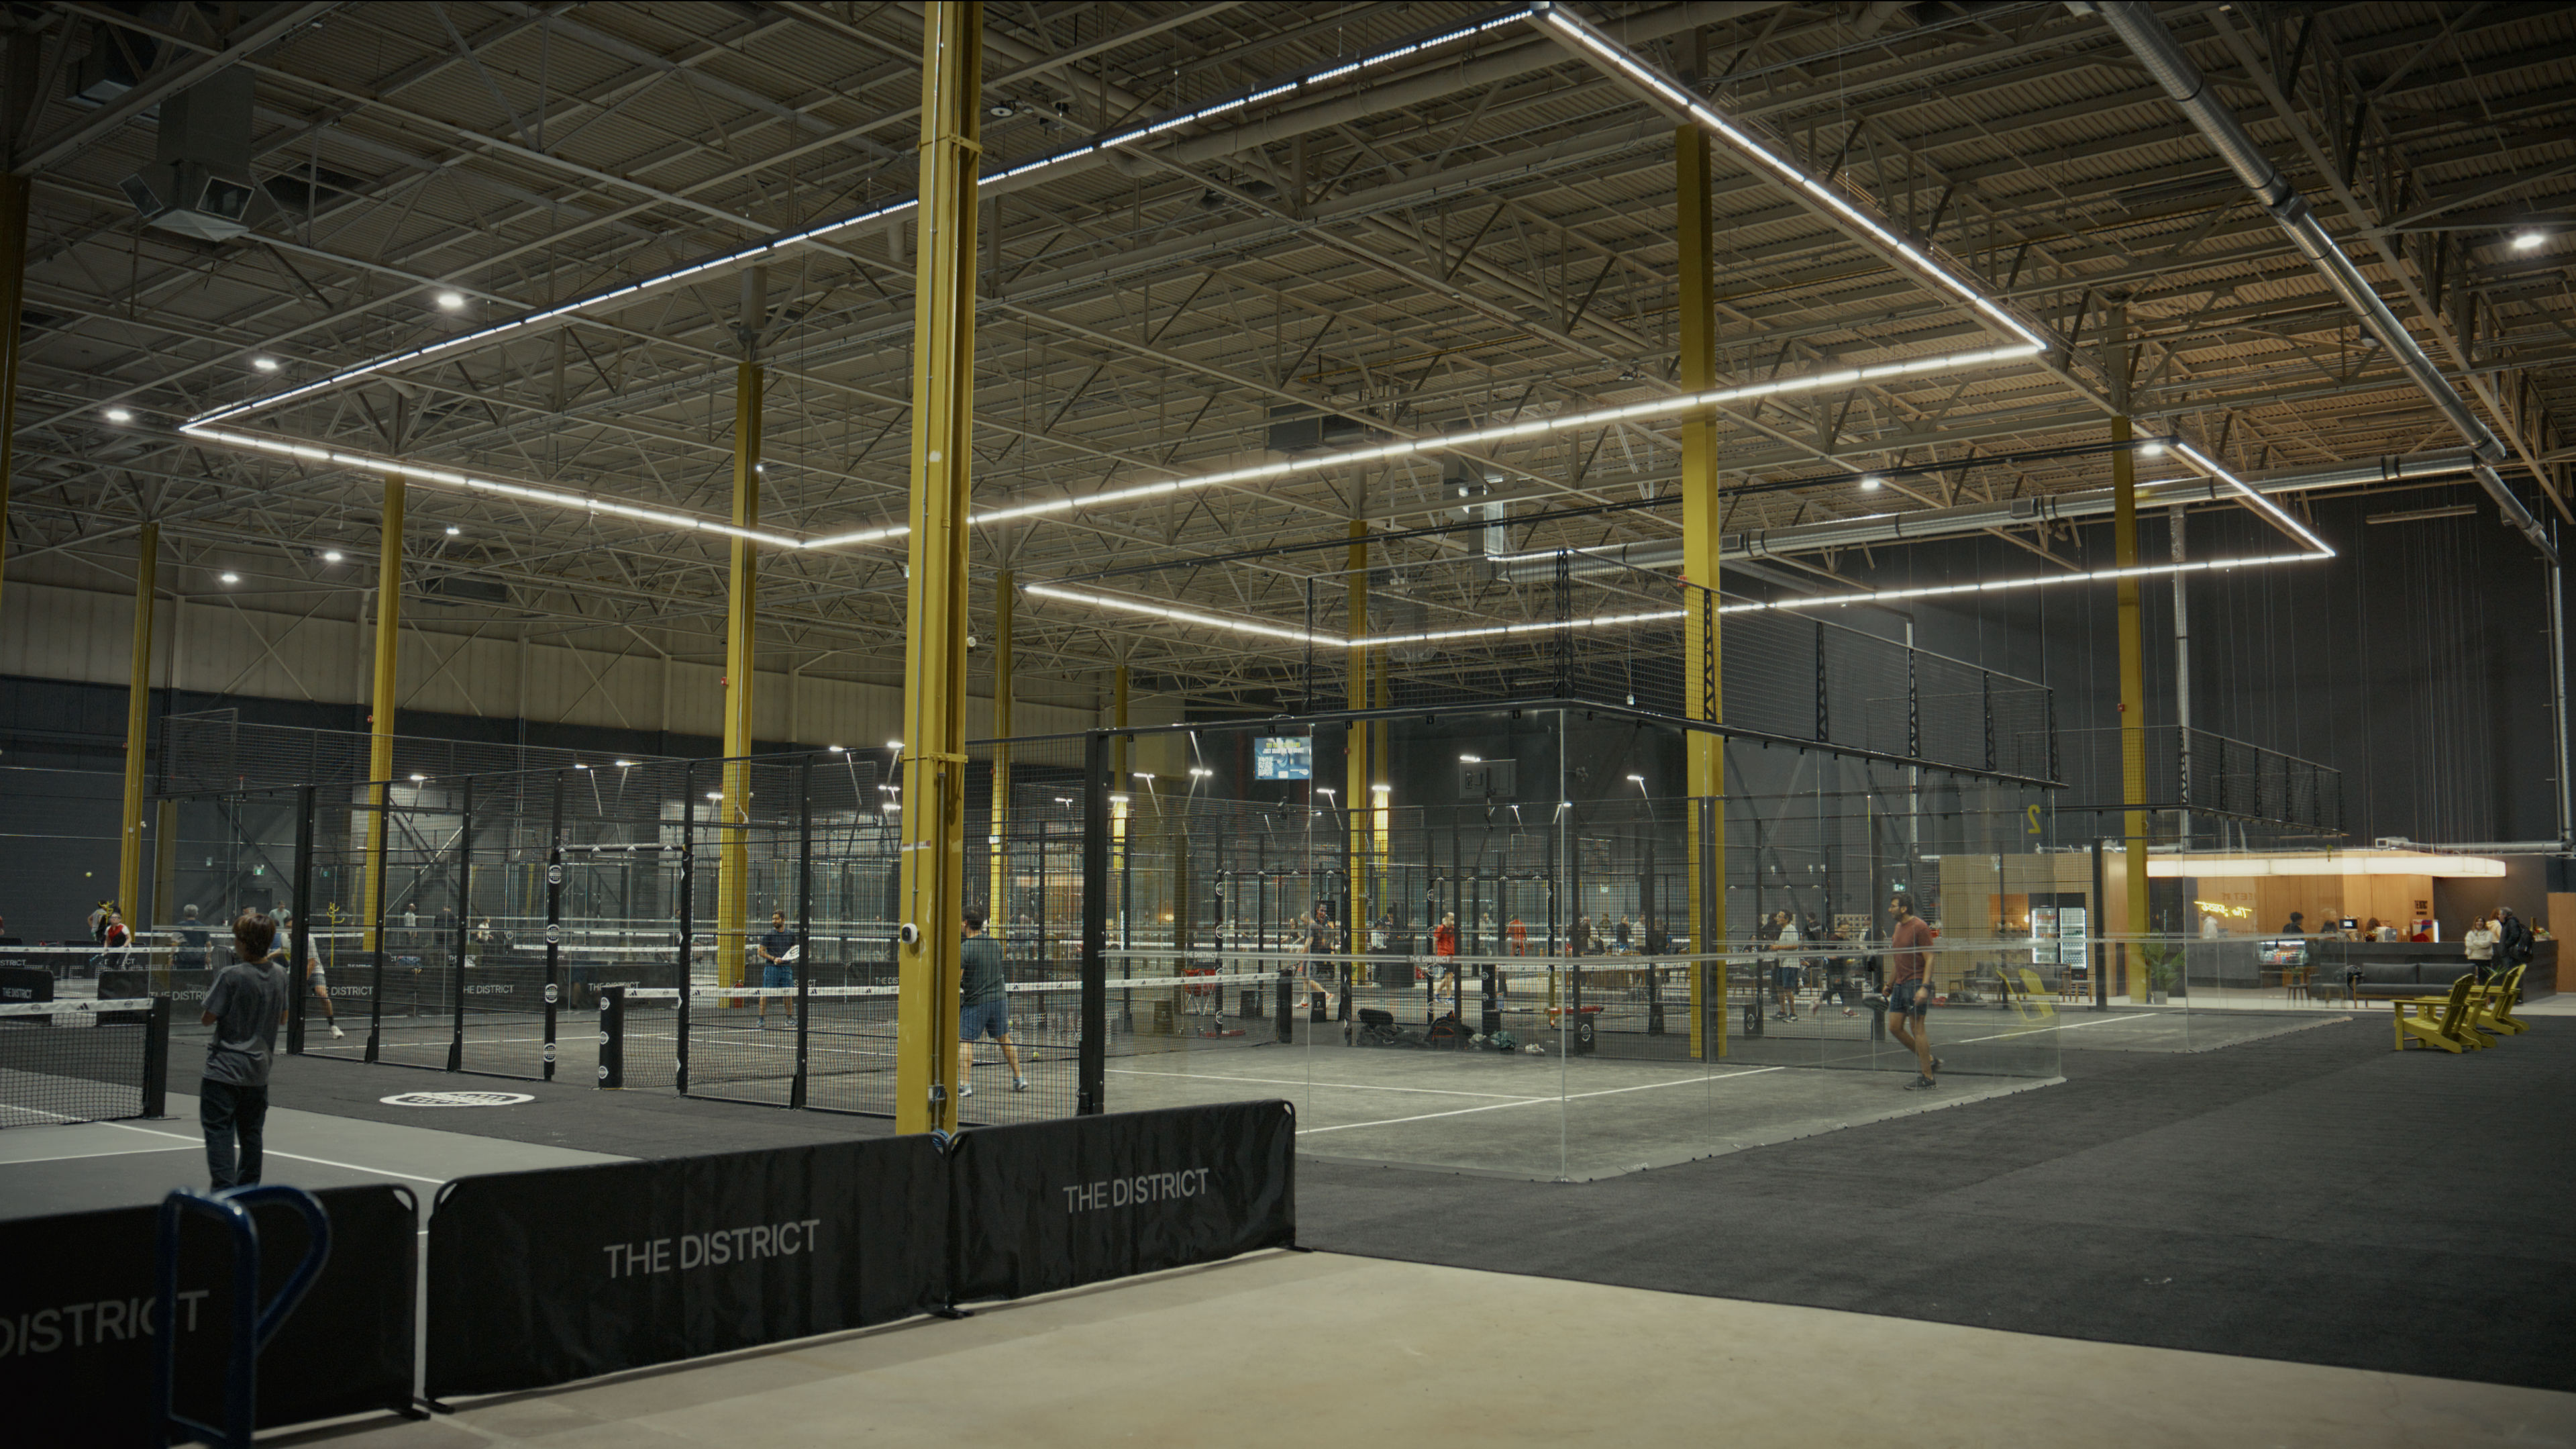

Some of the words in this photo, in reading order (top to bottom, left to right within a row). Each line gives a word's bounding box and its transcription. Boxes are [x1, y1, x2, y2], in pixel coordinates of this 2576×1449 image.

[331, 986, 374, 996] DISTRICT
[463, 985, 475, 994] HE
[476, 985, 514, 994] DISTRICT
[1063, 1181, 1108, 1213] THE
[1113, 1168, 1209, 1207] DISTRICT
[603, 1238, 671, 1279] THE
[680, 1219, 821, 1270] DISTRICT
